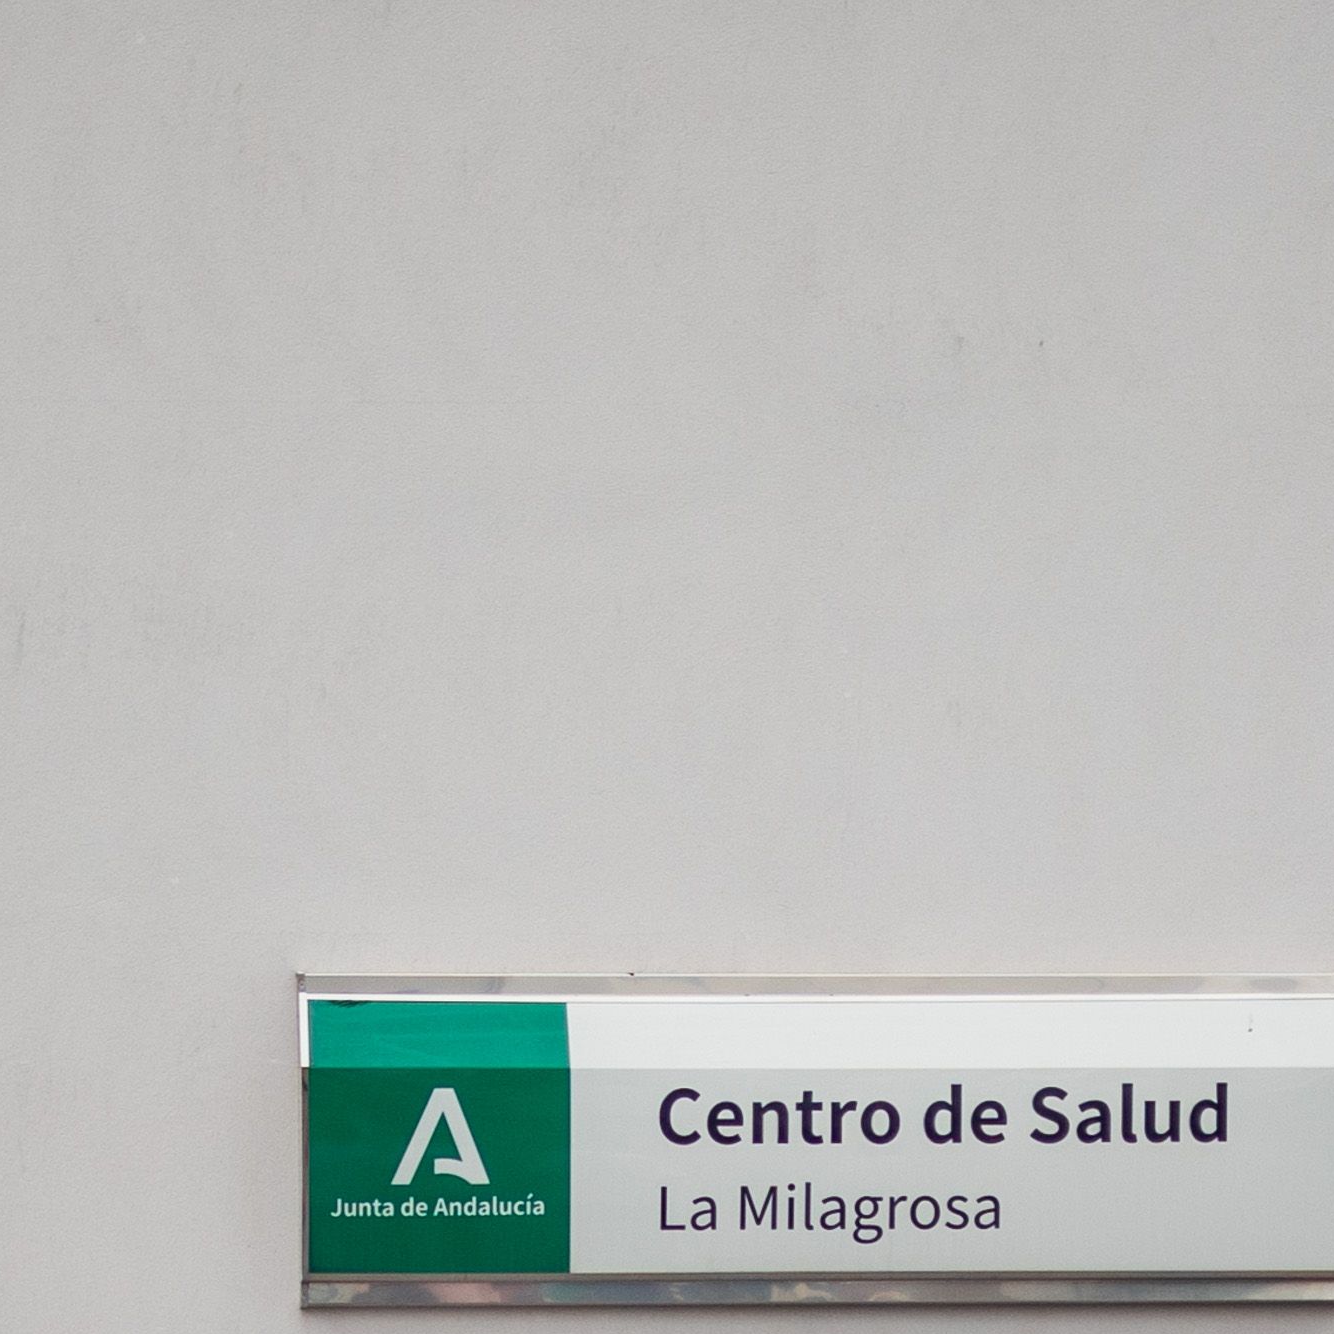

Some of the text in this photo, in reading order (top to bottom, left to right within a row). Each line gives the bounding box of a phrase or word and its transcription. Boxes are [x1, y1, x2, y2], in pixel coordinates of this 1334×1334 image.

[658, 1082, 1228, 1146] Centro de Salud
[330, 1192, 546, 1218] Junta de Andalucía
[660, 1181, 1001, 1245] La Milagrosa
